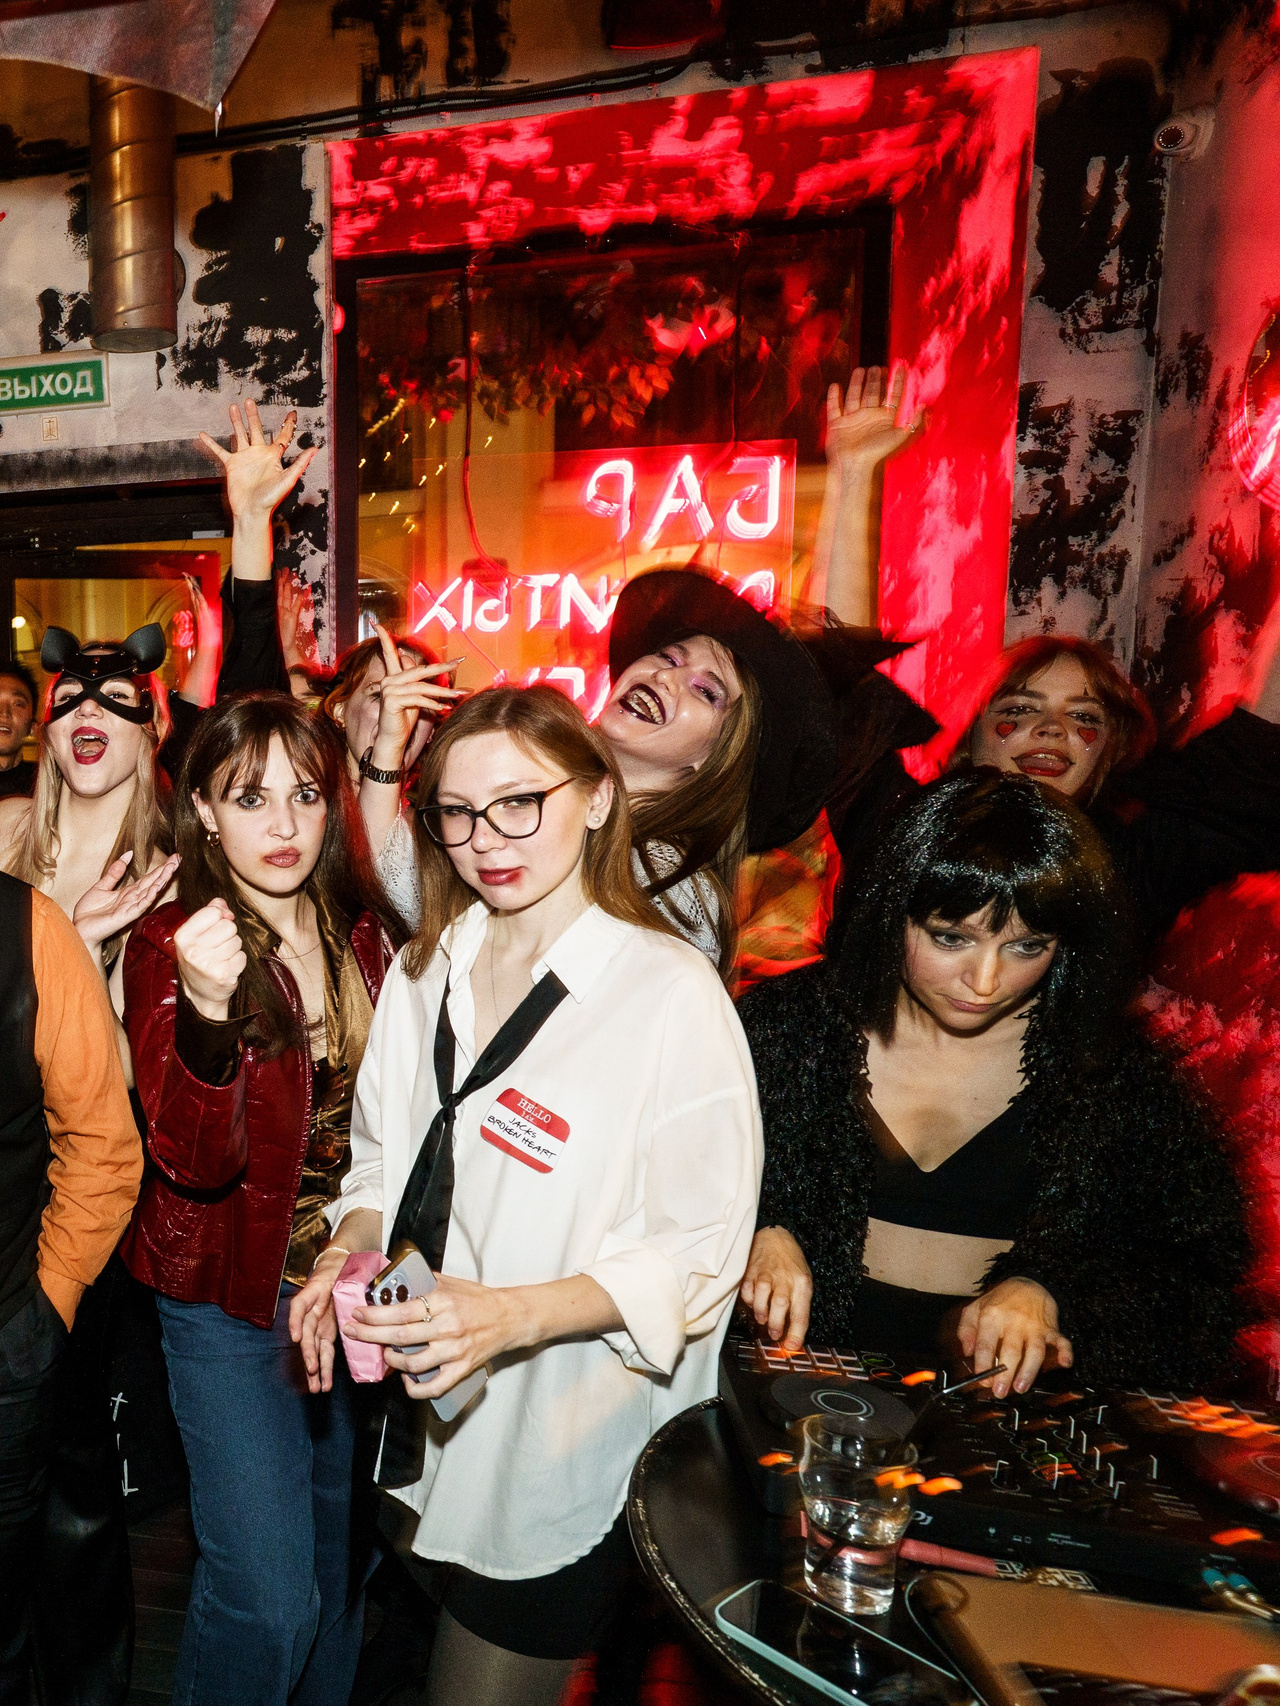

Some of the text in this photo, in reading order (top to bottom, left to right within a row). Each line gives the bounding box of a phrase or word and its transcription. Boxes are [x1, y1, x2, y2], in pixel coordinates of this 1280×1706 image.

[517, 1097, 551, 1124] HELLO
[487, 1115, 557, 1159] BROKEN HEART
